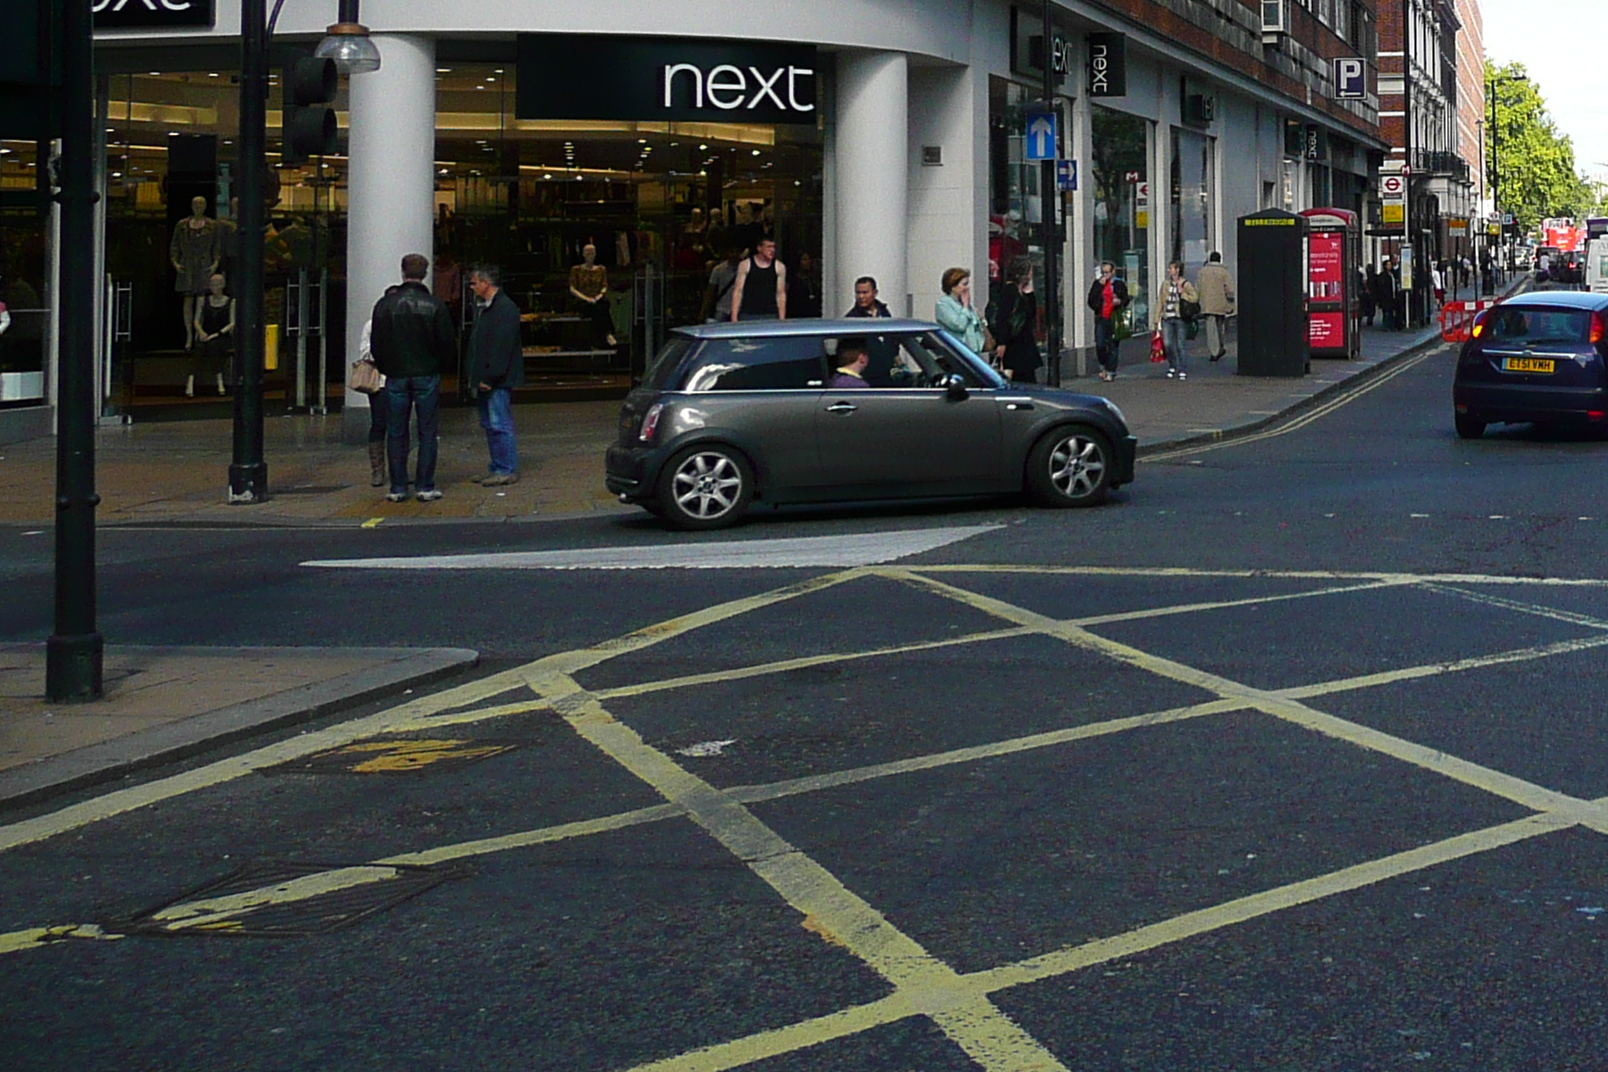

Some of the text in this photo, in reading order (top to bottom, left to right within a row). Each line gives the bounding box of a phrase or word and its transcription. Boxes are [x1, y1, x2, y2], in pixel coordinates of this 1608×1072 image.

[665, 62, 815, 112] next
[1093, 44, 1108, 93] next
[1340, 60, 1361, 90] P
[1308, 131, 1317, 158] next
